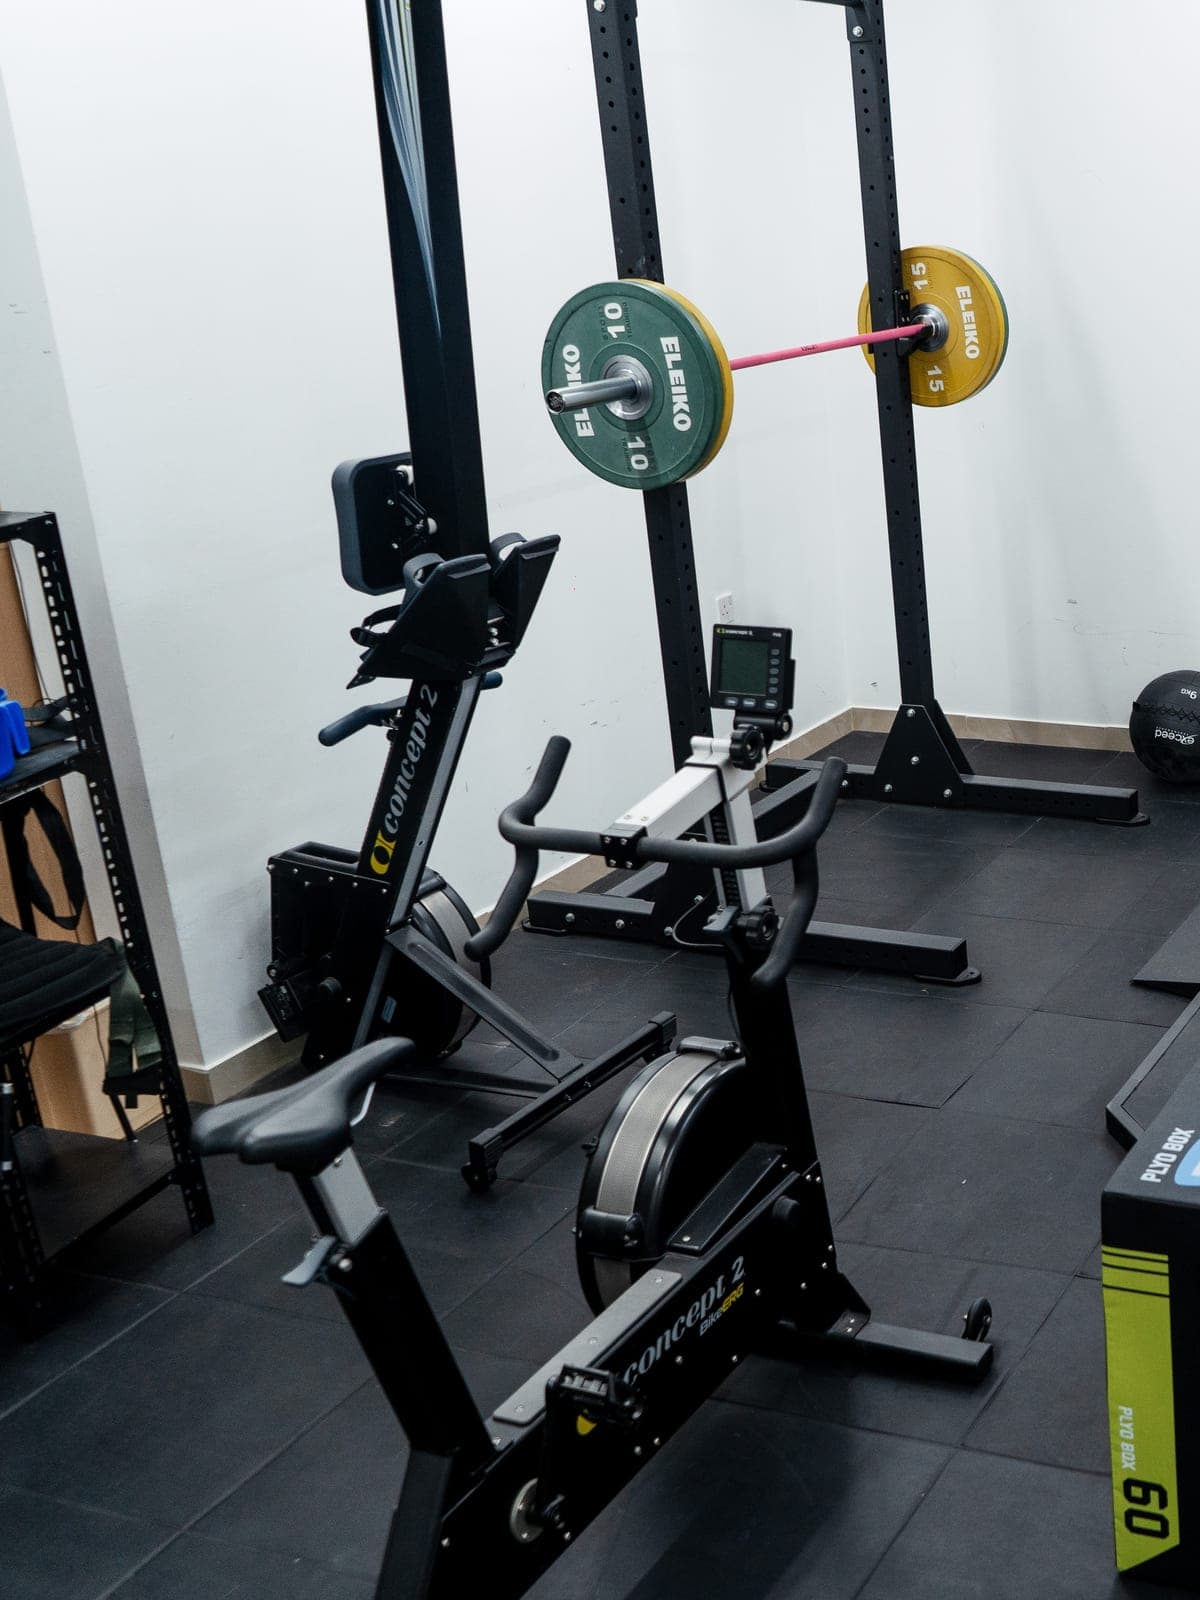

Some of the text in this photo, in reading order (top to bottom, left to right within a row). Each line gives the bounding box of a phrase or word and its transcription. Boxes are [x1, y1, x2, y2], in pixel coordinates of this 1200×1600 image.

[911, 262, 928, 290] 15
[603, 302, 626, 339] 10
[955, 285, 980, 359] ELEIKO
[562, 344, 595, 437] ELIKO
[660, 336, 692, 432] ELEIKO
[927, 365, 945, 392] 15
[627, 436, 649, 470] 10
[384, 684, 439, 835] concept 2
[1155, 729, 1197, 745] exceed
[1140, 1127, 1195, 1183] PLYO BOX
[623, 1255, 745, 1385] concept 2
[1118, 1405, 1170, 1539] PLYO BOX 60
